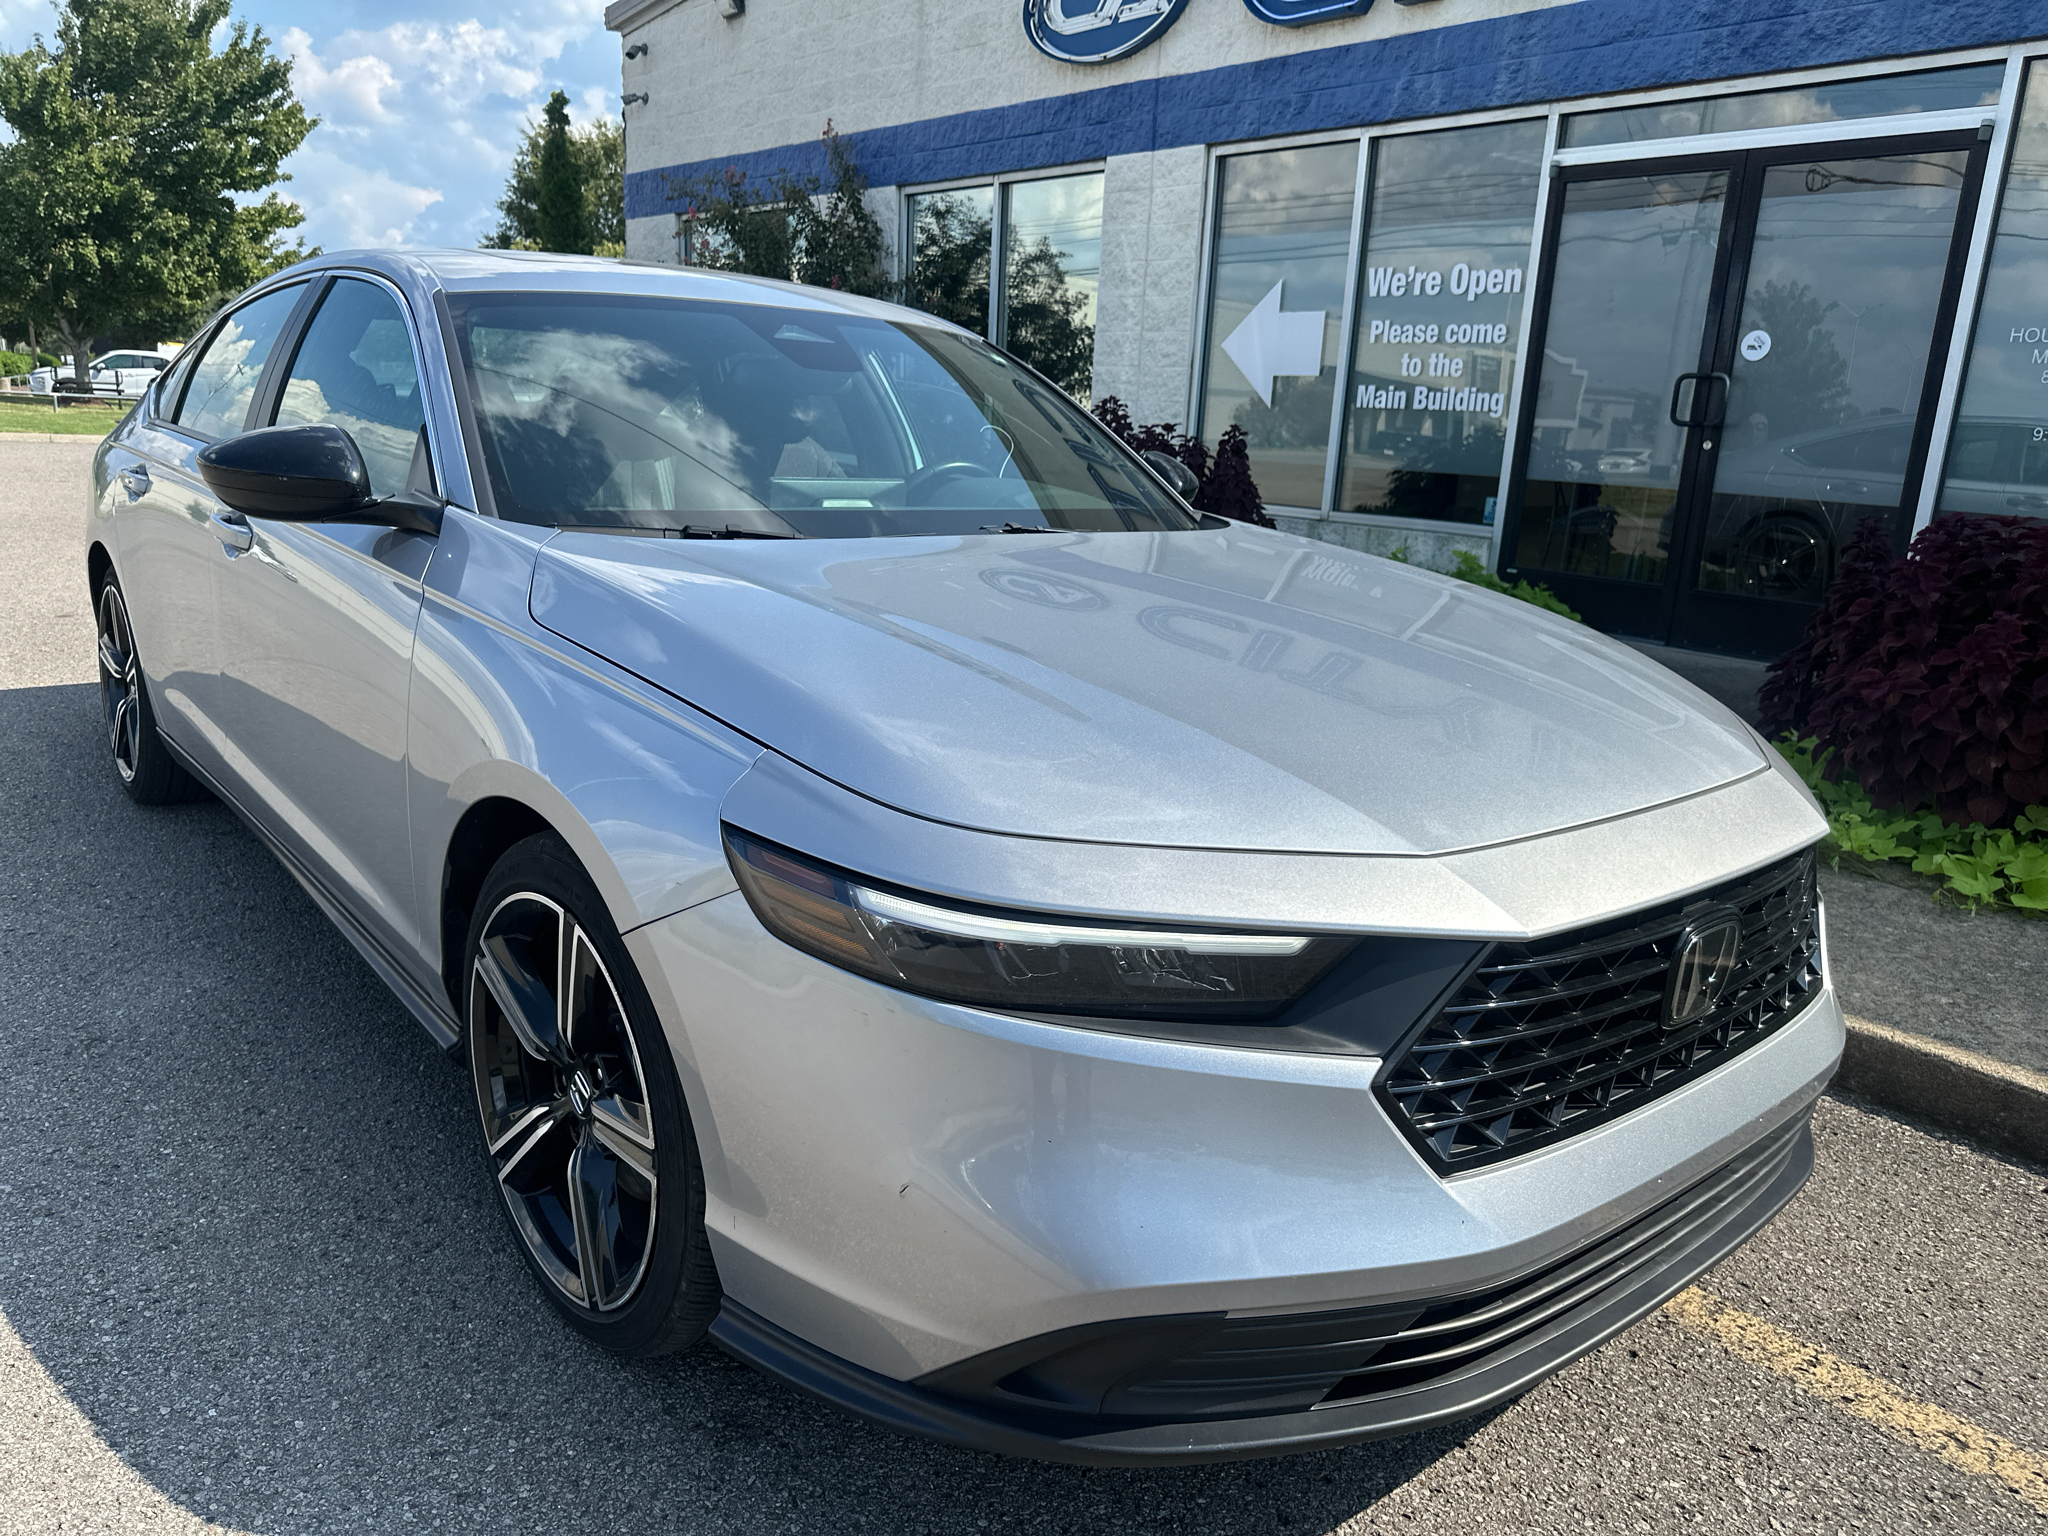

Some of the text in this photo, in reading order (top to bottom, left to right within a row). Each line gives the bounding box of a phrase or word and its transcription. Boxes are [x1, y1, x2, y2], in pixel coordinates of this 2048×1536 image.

[1368, 262, 1522, 302] We're Open
[1369, 319, 1507, 344] Please come
[1401, 352, 1463, 378] to the
[1356, 384, 1505, 418] Main Building
